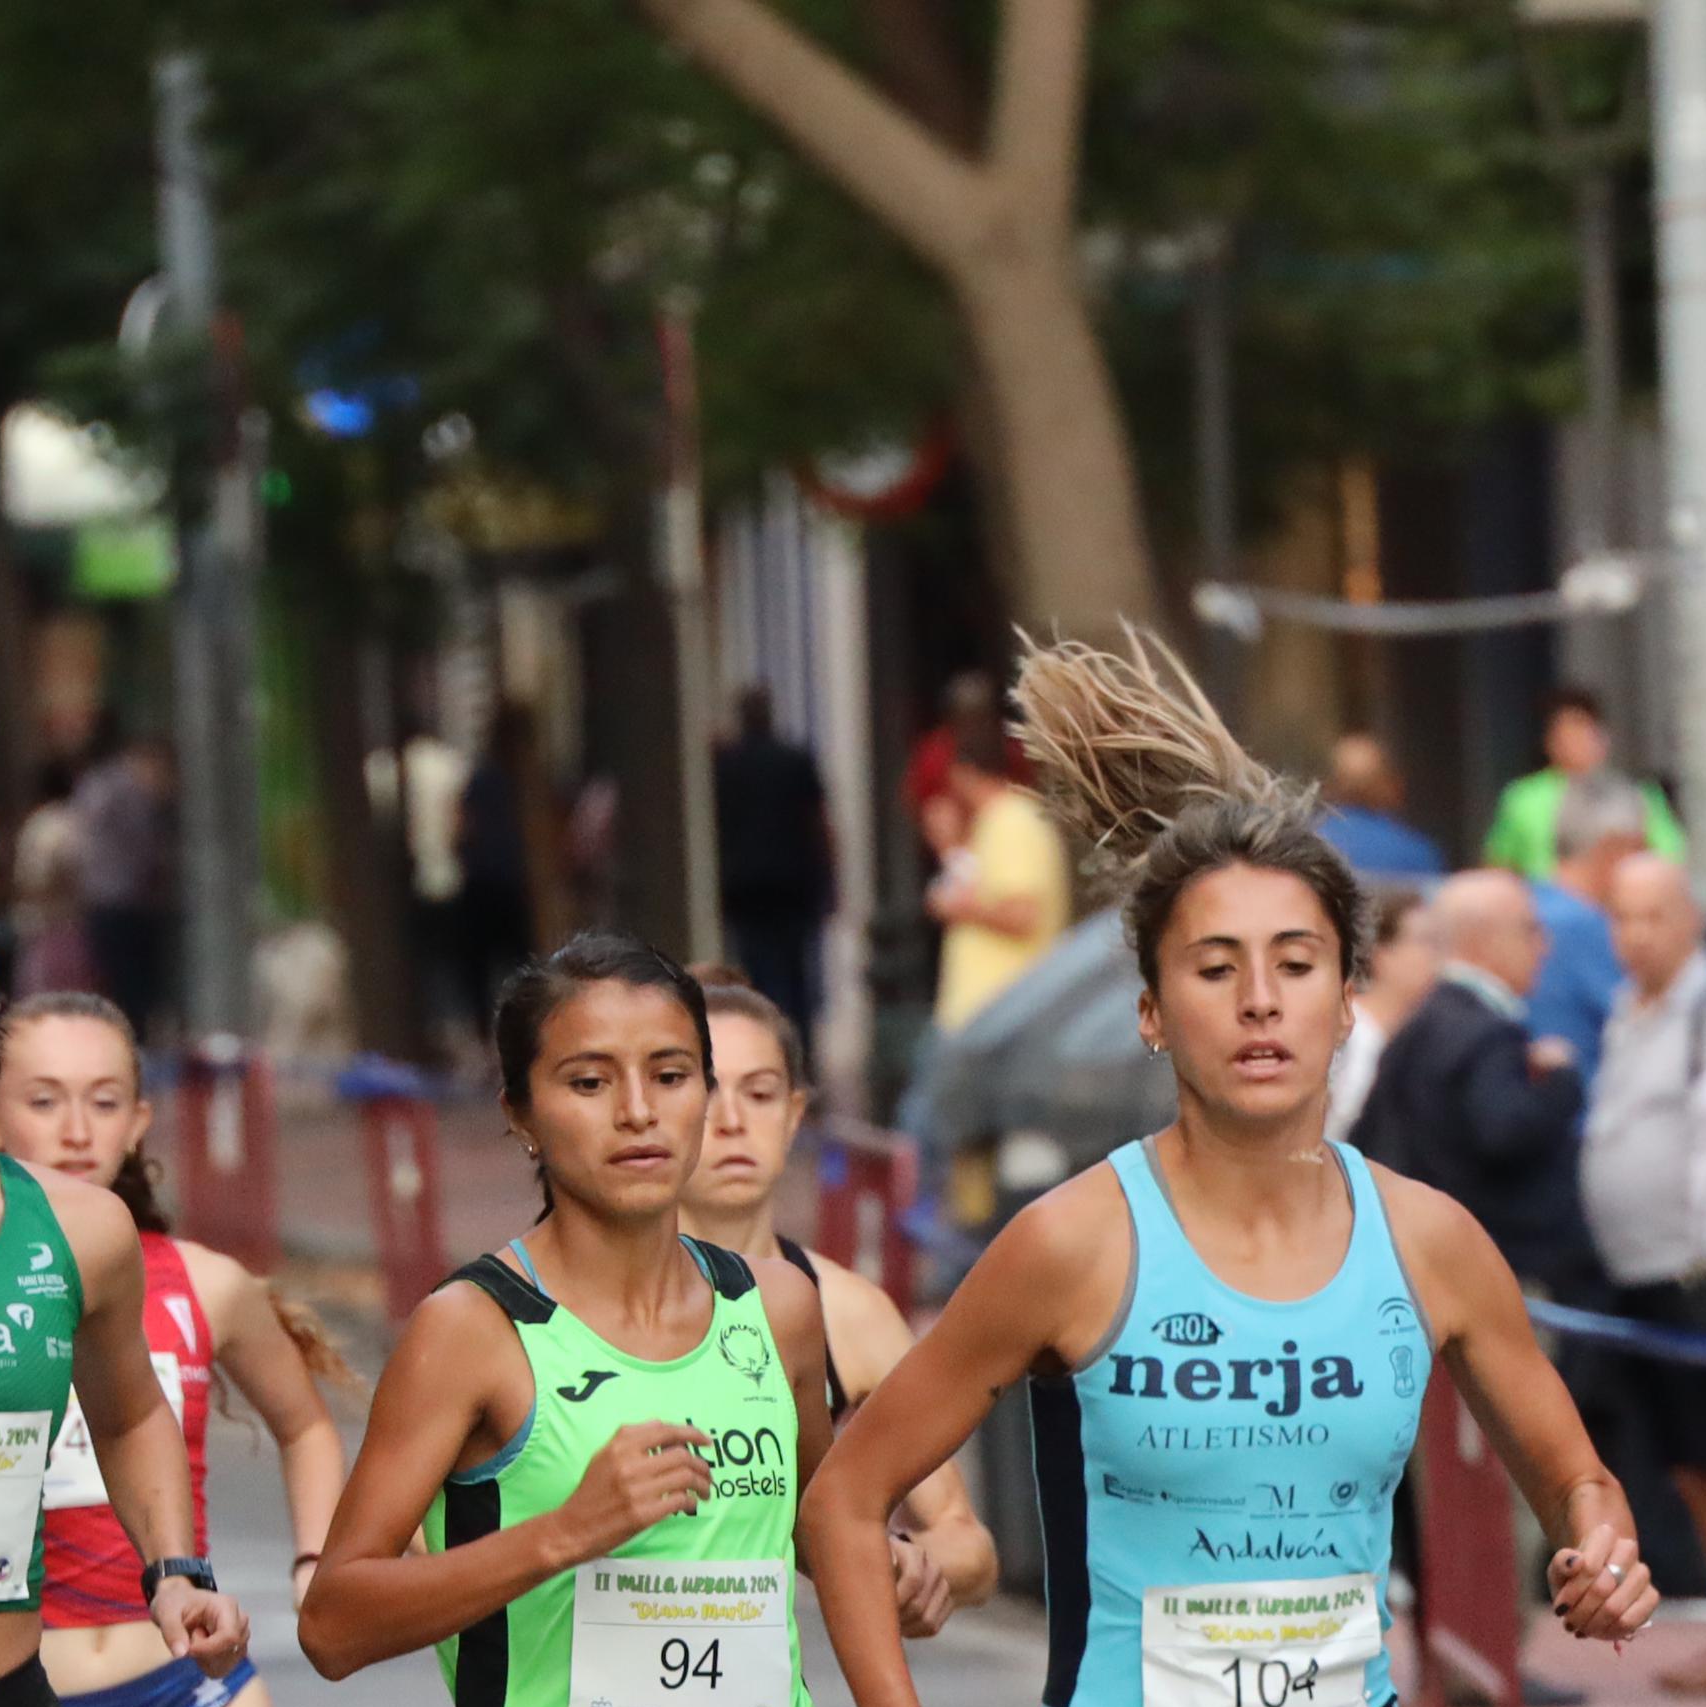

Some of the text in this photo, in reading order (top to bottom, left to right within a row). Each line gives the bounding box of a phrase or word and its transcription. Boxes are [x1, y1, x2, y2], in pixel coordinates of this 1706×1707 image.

[1109, 1340, 1364, 1418] nerja
[1136, 1423, 1330, 1451] ATLETISMO
[1189, 1527, 1342, 1562] Andalucía
[750, 1575, 779, 1594] 2024
[660, 1637, 723, 1690] 94
